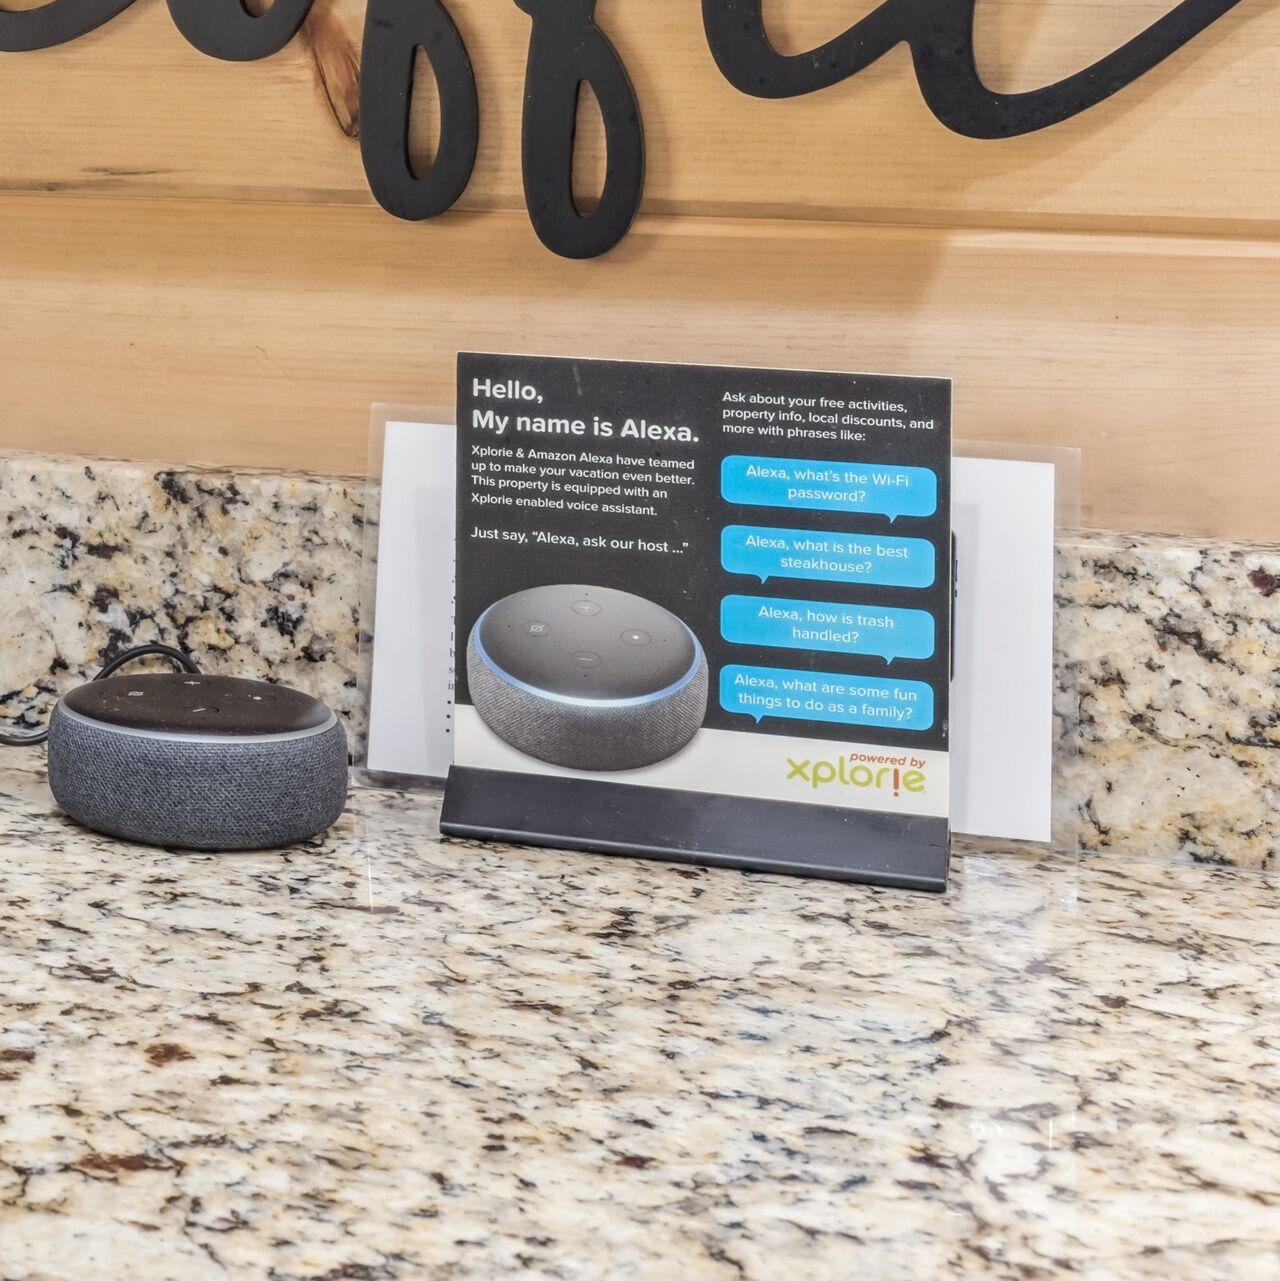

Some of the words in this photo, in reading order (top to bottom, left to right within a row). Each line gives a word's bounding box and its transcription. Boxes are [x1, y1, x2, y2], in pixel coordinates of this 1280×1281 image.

[472, 378, 544, 404] Hello,
[722, 391, 746, 403] Ask
[749, 393, 785, 405] about
[788, 397, 816, 408] your
[820, 397, 845, 409] free
[848, 400, 908, 413] activities,
[472, 409, 509, 434] My
[516, 416, 585, 435] name
[593, 416, 613, 437] is
[620, 419, 699, 442] Alexa.
[722, 409, 775, 422] property
[779, 410, 806, 423] info,
[809, 412, 838, 424] local
[842, 414, 906, 429] discounts,
[909, 420, 934, 429] and
[722, 424, 754, 434] more
[758, 425, 784, 436] with
[787, 427, 837, 440] phrases
[840, 429, 866, 441] like:
[471, 445, 513, 458] Xplorie
[516, 448, 525, 458] &
[528, 449, 576, 462] Amazon
[579, 452, 613, 464] Alexa
[616, 454, 645, 466] have
[649, 457, 695, 470] teamed
[471, 462, 486, 472] up
[489, 462, 501, 471] to
[504, 464, 536, 474] make
[539, 467, 566, 477] your
[569, 468, 619, 480] vacation
[622, 472, 652, 482] even
[655, 473, 695, 485] better.
[746, 464, 790, 481] Alexa,
[795, 469, 839, 483] what’s
[844, 472, 868, 484] the
[872, 473, 909, 487] Wi-Fi
[471, 475, 496, 486] This
[498, 479, 548, 492] property
[551, 480, 561, 491] is
[564, 483, 621, 496] equipped
[624, 486, 649, 497] with
[652, 490, 668, 498] an
[788, 488, 866, 503] password?
[471, 493, 513, 505] Xplorie
[516, 497, 564, 509] enabled
[567, 500, 598, 511] voice
[602, 503, 657, 516] assistant.
[471, 526, 499, 540] Just
[502, 531, 528, 544] say,
[532, 530, 579, 547] “Alexa,
[583, 536, 606, 548] ask
[610, 539, 634, 550] our
[638, 539, 668, 553] host
[746, 535, 790, 551] Alexa,
[794, 539, 829, 553] what
[833, 541, 844, 554] is
[848, 543, 872, 555] the
[877, 545, 909, 559] best
[781, 557, 872, 574] steakhouse?
[758, 606, 802, 622] Alexa,
[807, 610, 838, 623] how
[842, 613, 853, 625] is
[858, 615, 894, 628] trash
[792, 627, 859, 644] handled?
[734, 674, 778, 690] Alexa,
[782, 679, 817, 693] what
[821, 684, 845, 695] are
[849, 686, 889, 699] some
[894, 688, 917, 701] fun
[738, 693, 782, 709] things
[786, 697, 801, 709] to
[805, 698, 823, 711] do
[828, 702, 844, 713] as
[848, 705, 857, 714] a
[862, 704, 912, 721] family?
[849, 753, 907, 766] powered
[910, 757, 926, 769] by
